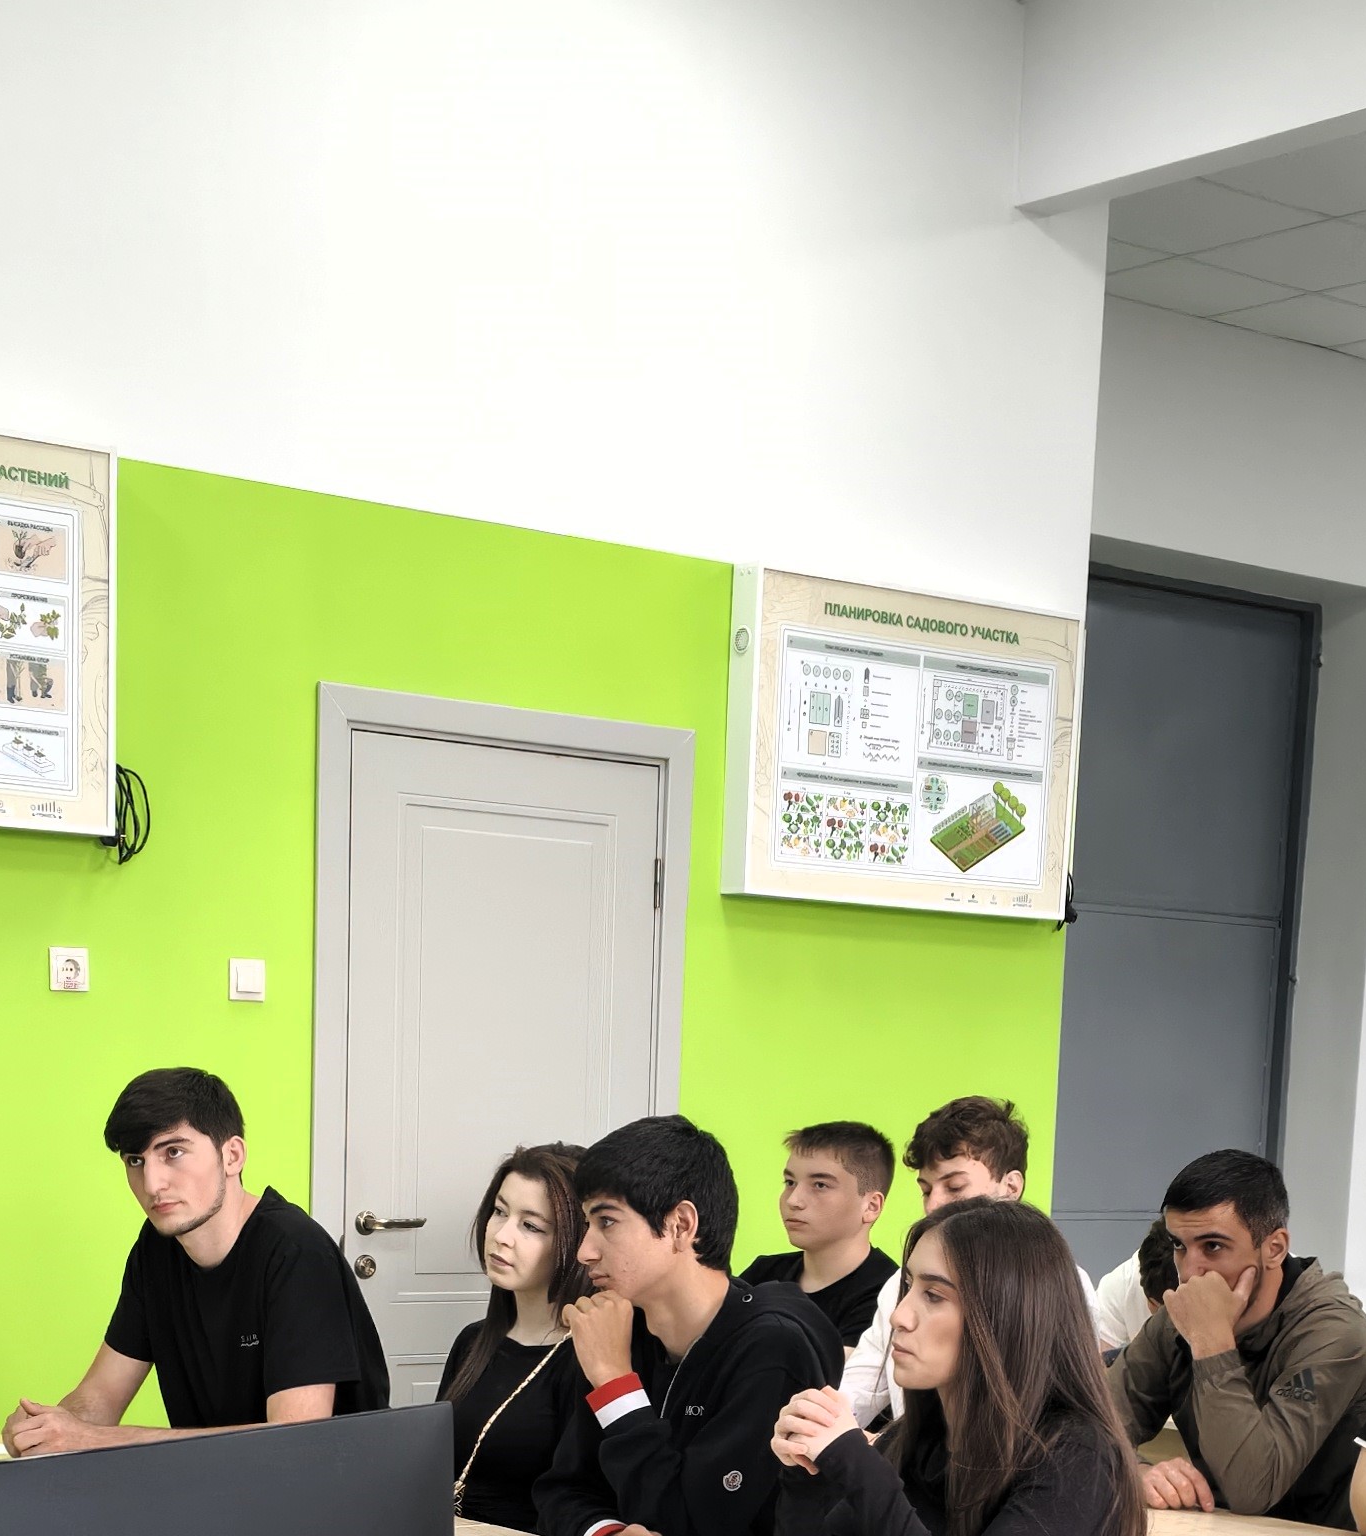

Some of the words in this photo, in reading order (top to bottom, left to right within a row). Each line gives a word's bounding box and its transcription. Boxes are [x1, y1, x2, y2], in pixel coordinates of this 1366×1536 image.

[824, 602, 903, 628] ПЛАНИРОВКА
[906, 615, 968, 636] САДОВОГО
[970, 625, 1020, 646] УЧАСТКА
